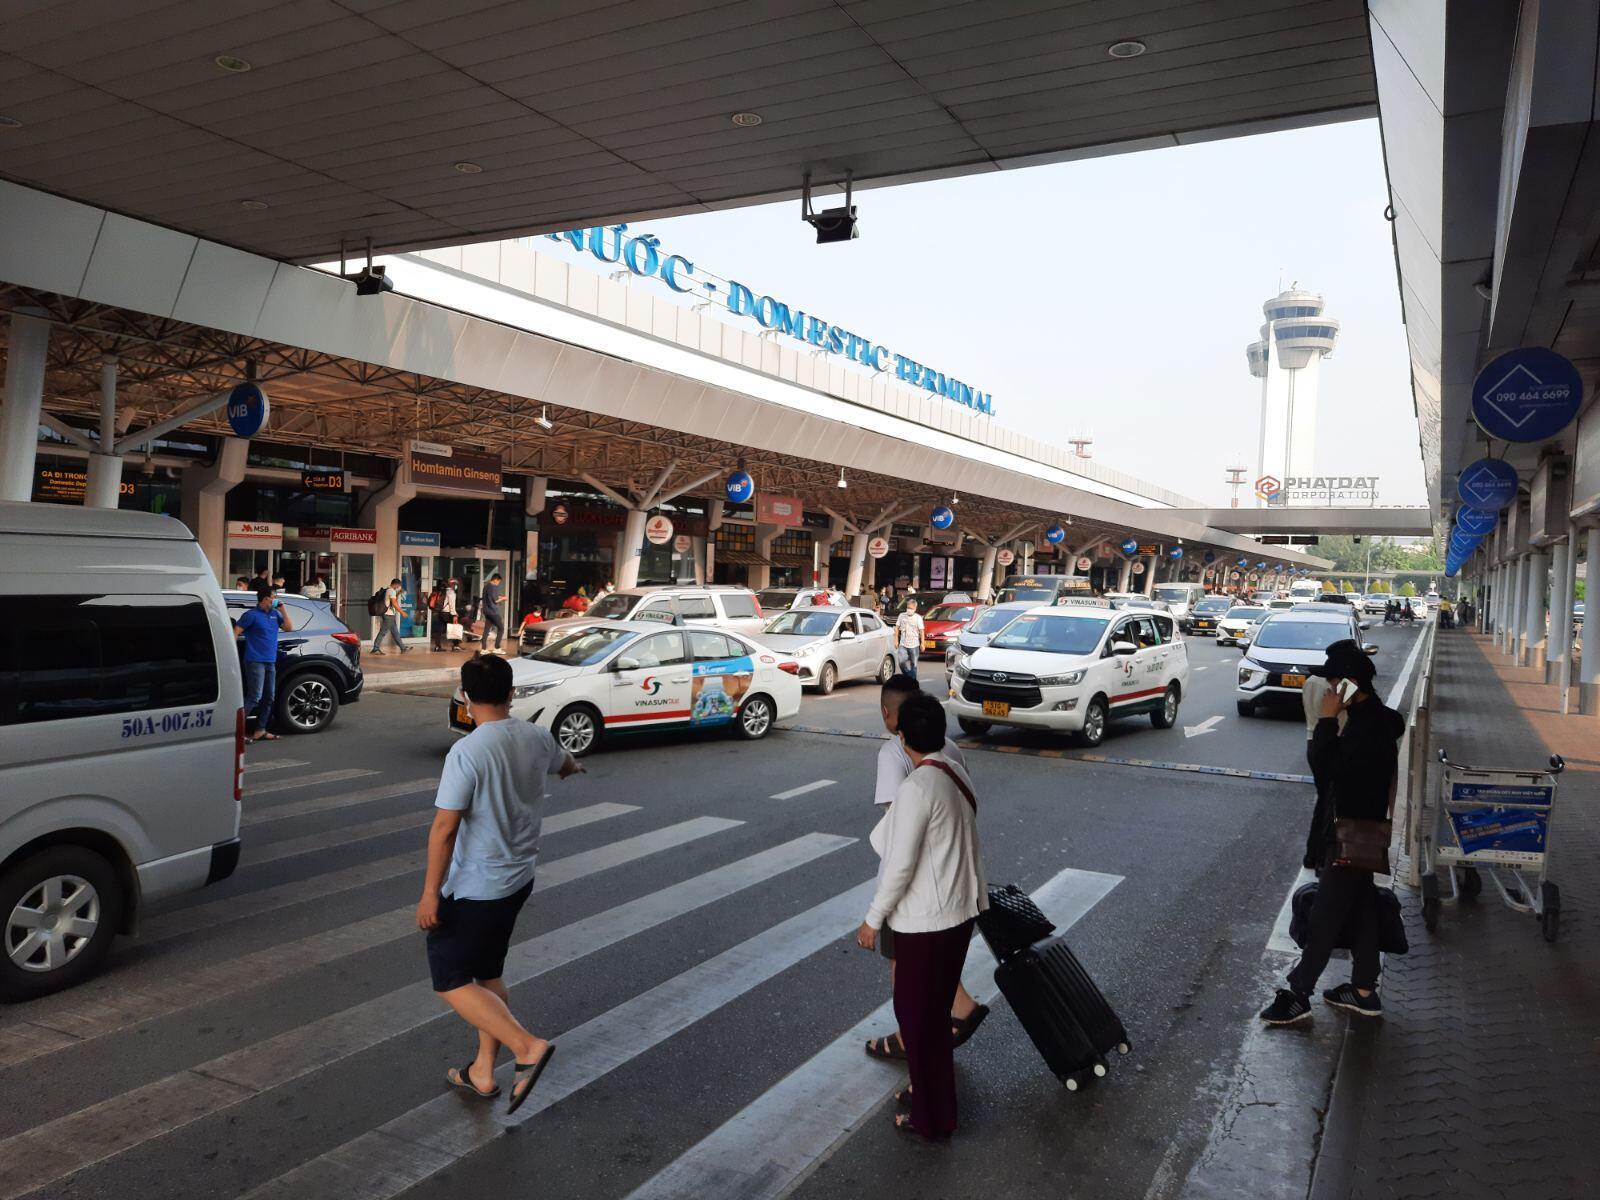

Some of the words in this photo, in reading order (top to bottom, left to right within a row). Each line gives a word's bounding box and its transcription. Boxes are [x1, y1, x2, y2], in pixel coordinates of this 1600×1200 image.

[727, 280, 890, 372] DOMESTIC
[895, 353, 996, 417] TERMINAL
[1496, 391, 1516, 402] 090
[1519, 391, 1539, 401] 464
[1542, 389, 1570, 400] 6699
[229, 404, 248, 418] VIB
[412, 460, 462, 477] Homtamin
[463, 467, 500, 484] Ginseng
[329, 475, 342, 488] D3
[1284, 477, 1380, 489] PHATDAT
[119, 483, 135, 494] D3
[727, 484, 742, 492] VIB
[1284, 491, 1380, 499] CORPORATION
[253, 525, 269, 533] MSB
[334, 532, 374, 541] AGRIBANK
[121, 709, 214, 738] 50A-007.37
